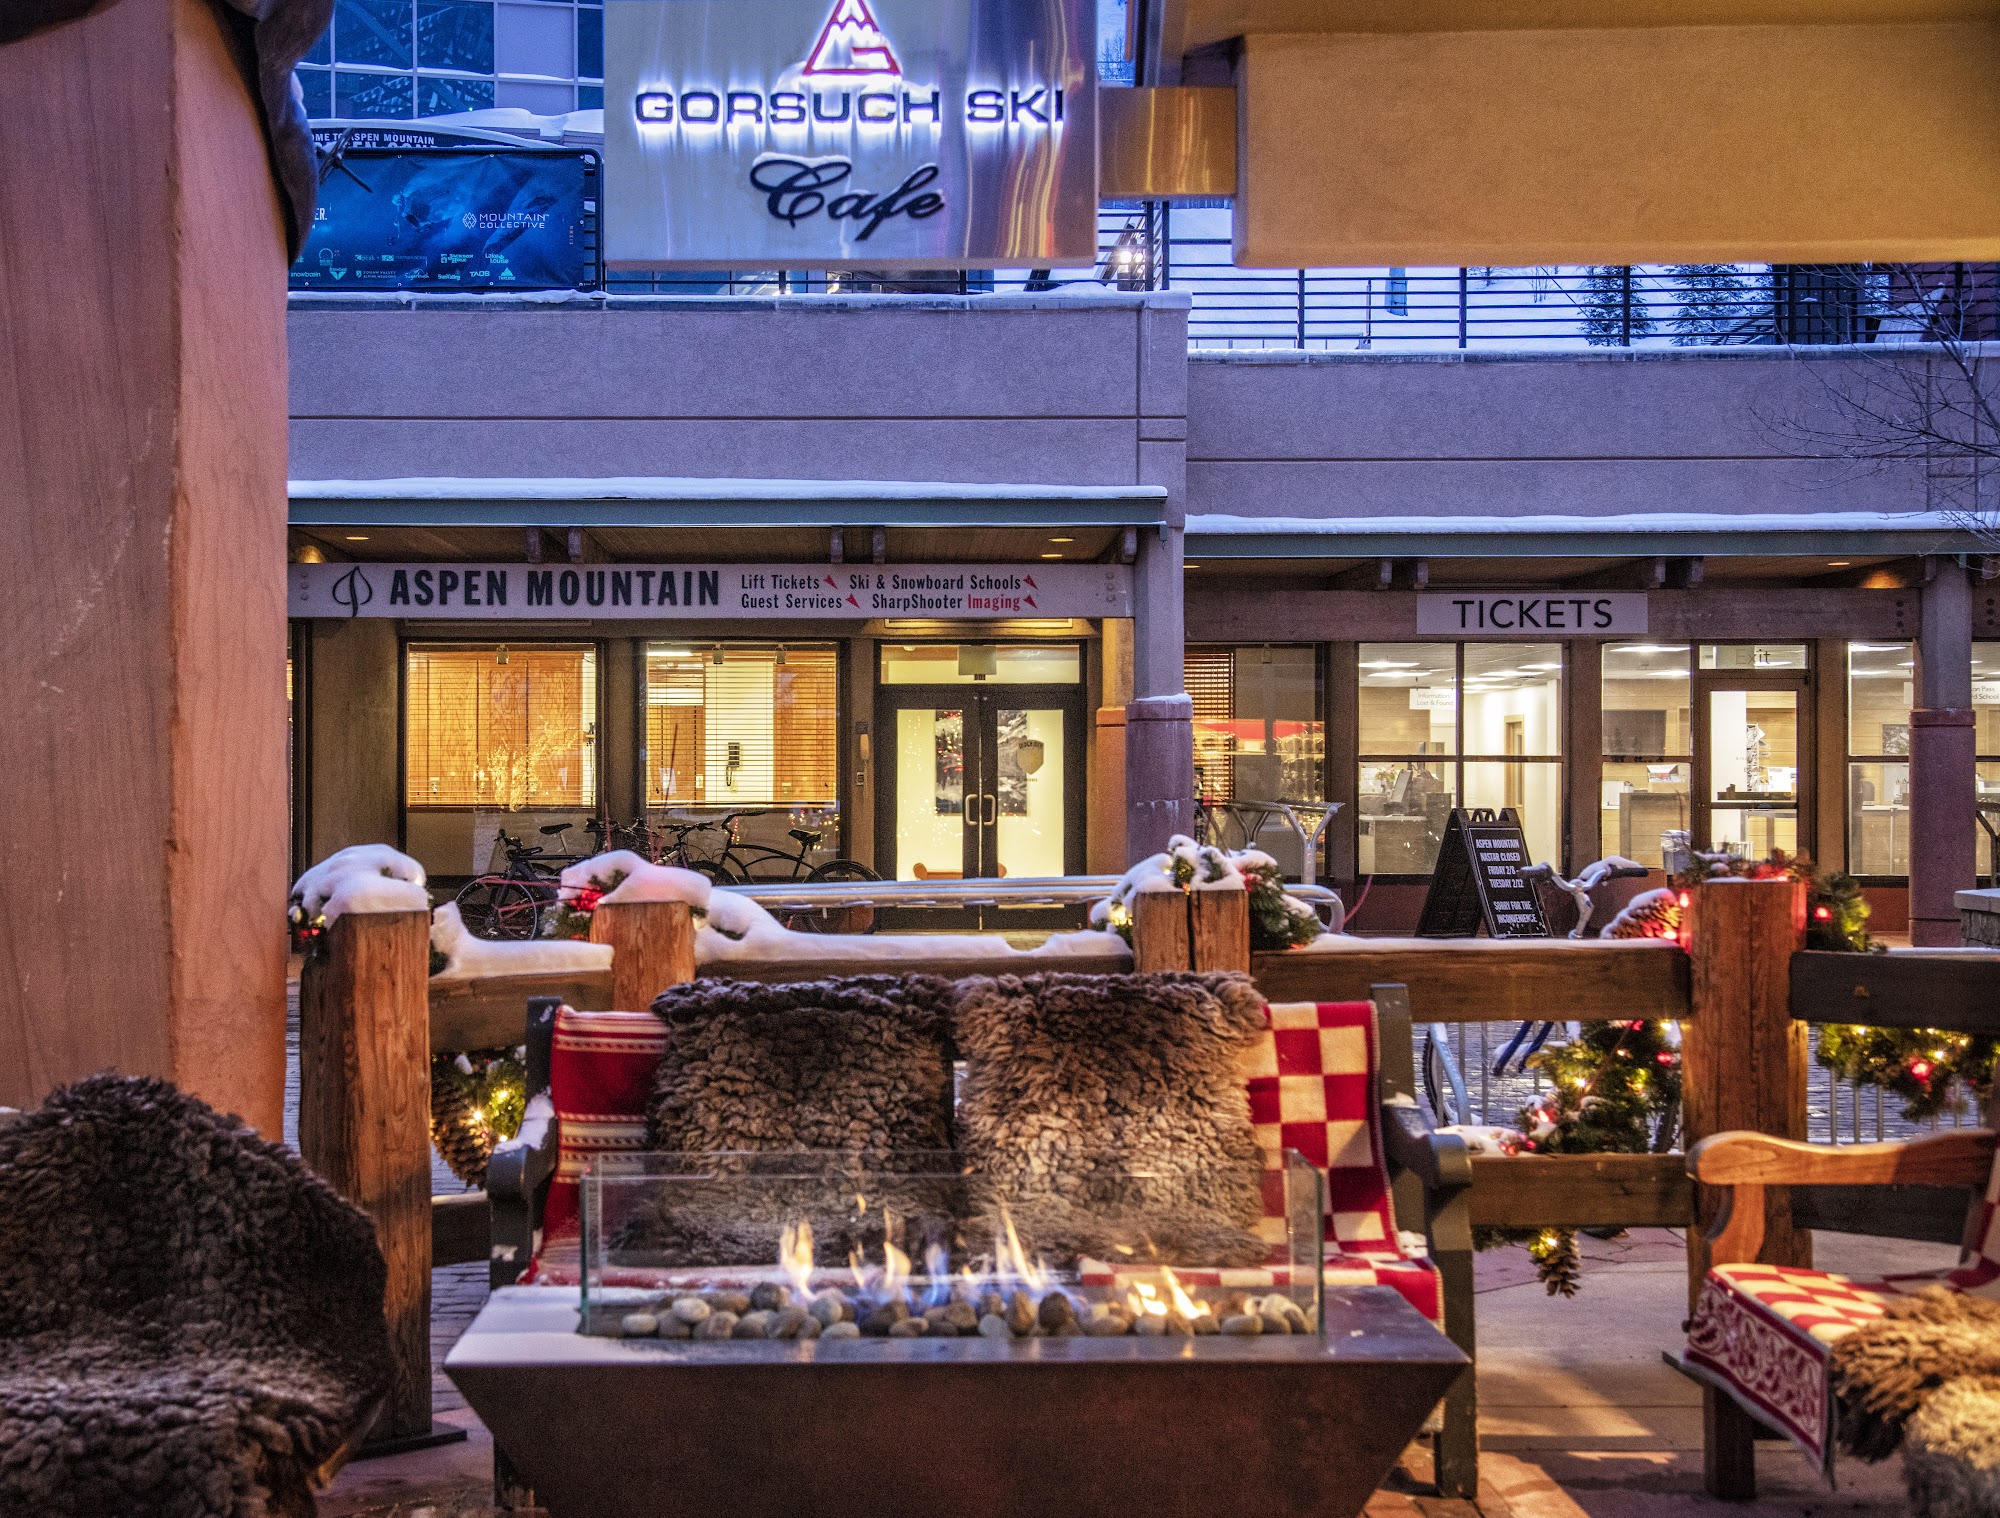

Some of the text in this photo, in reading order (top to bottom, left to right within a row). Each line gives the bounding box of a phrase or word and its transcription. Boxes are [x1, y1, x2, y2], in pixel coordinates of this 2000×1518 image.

[635, 90, 1064, 123] GORSUCH SKI
[384, 133, 435, 145] MOUNTAIN
[749, 158, 946, 241] Cafe
[480, 213, 546, 222] MOUNTAIN
[390, 569, 719, 606] ASPEN MOUNTAIN
[741, 574, 820, 590] Lift Tickets
[849, 574, 1021, 590] Ski & Snowboard Schools
[741, 593, 842, 609] Guest Services
[872, 593, 1021, 611] SharpShooter Imaging
[1452, 599, 1613, 629] TICKETS
[1736, 649, 1771, 665] Exit
[1475, 839, 1520, 849] ASPEN MOUNTAIN
[1480, 852, 1521, 862] NASTAR CLOSED
[1487, 865, 1506, 875] FRIDAY
[1489, 878, 1524, 888] TUESDAY 2/12
[1493, 901, 1533, 912] SORRY FOR THE
[1496, 913, 1538, 923] INCONVENIENCE
